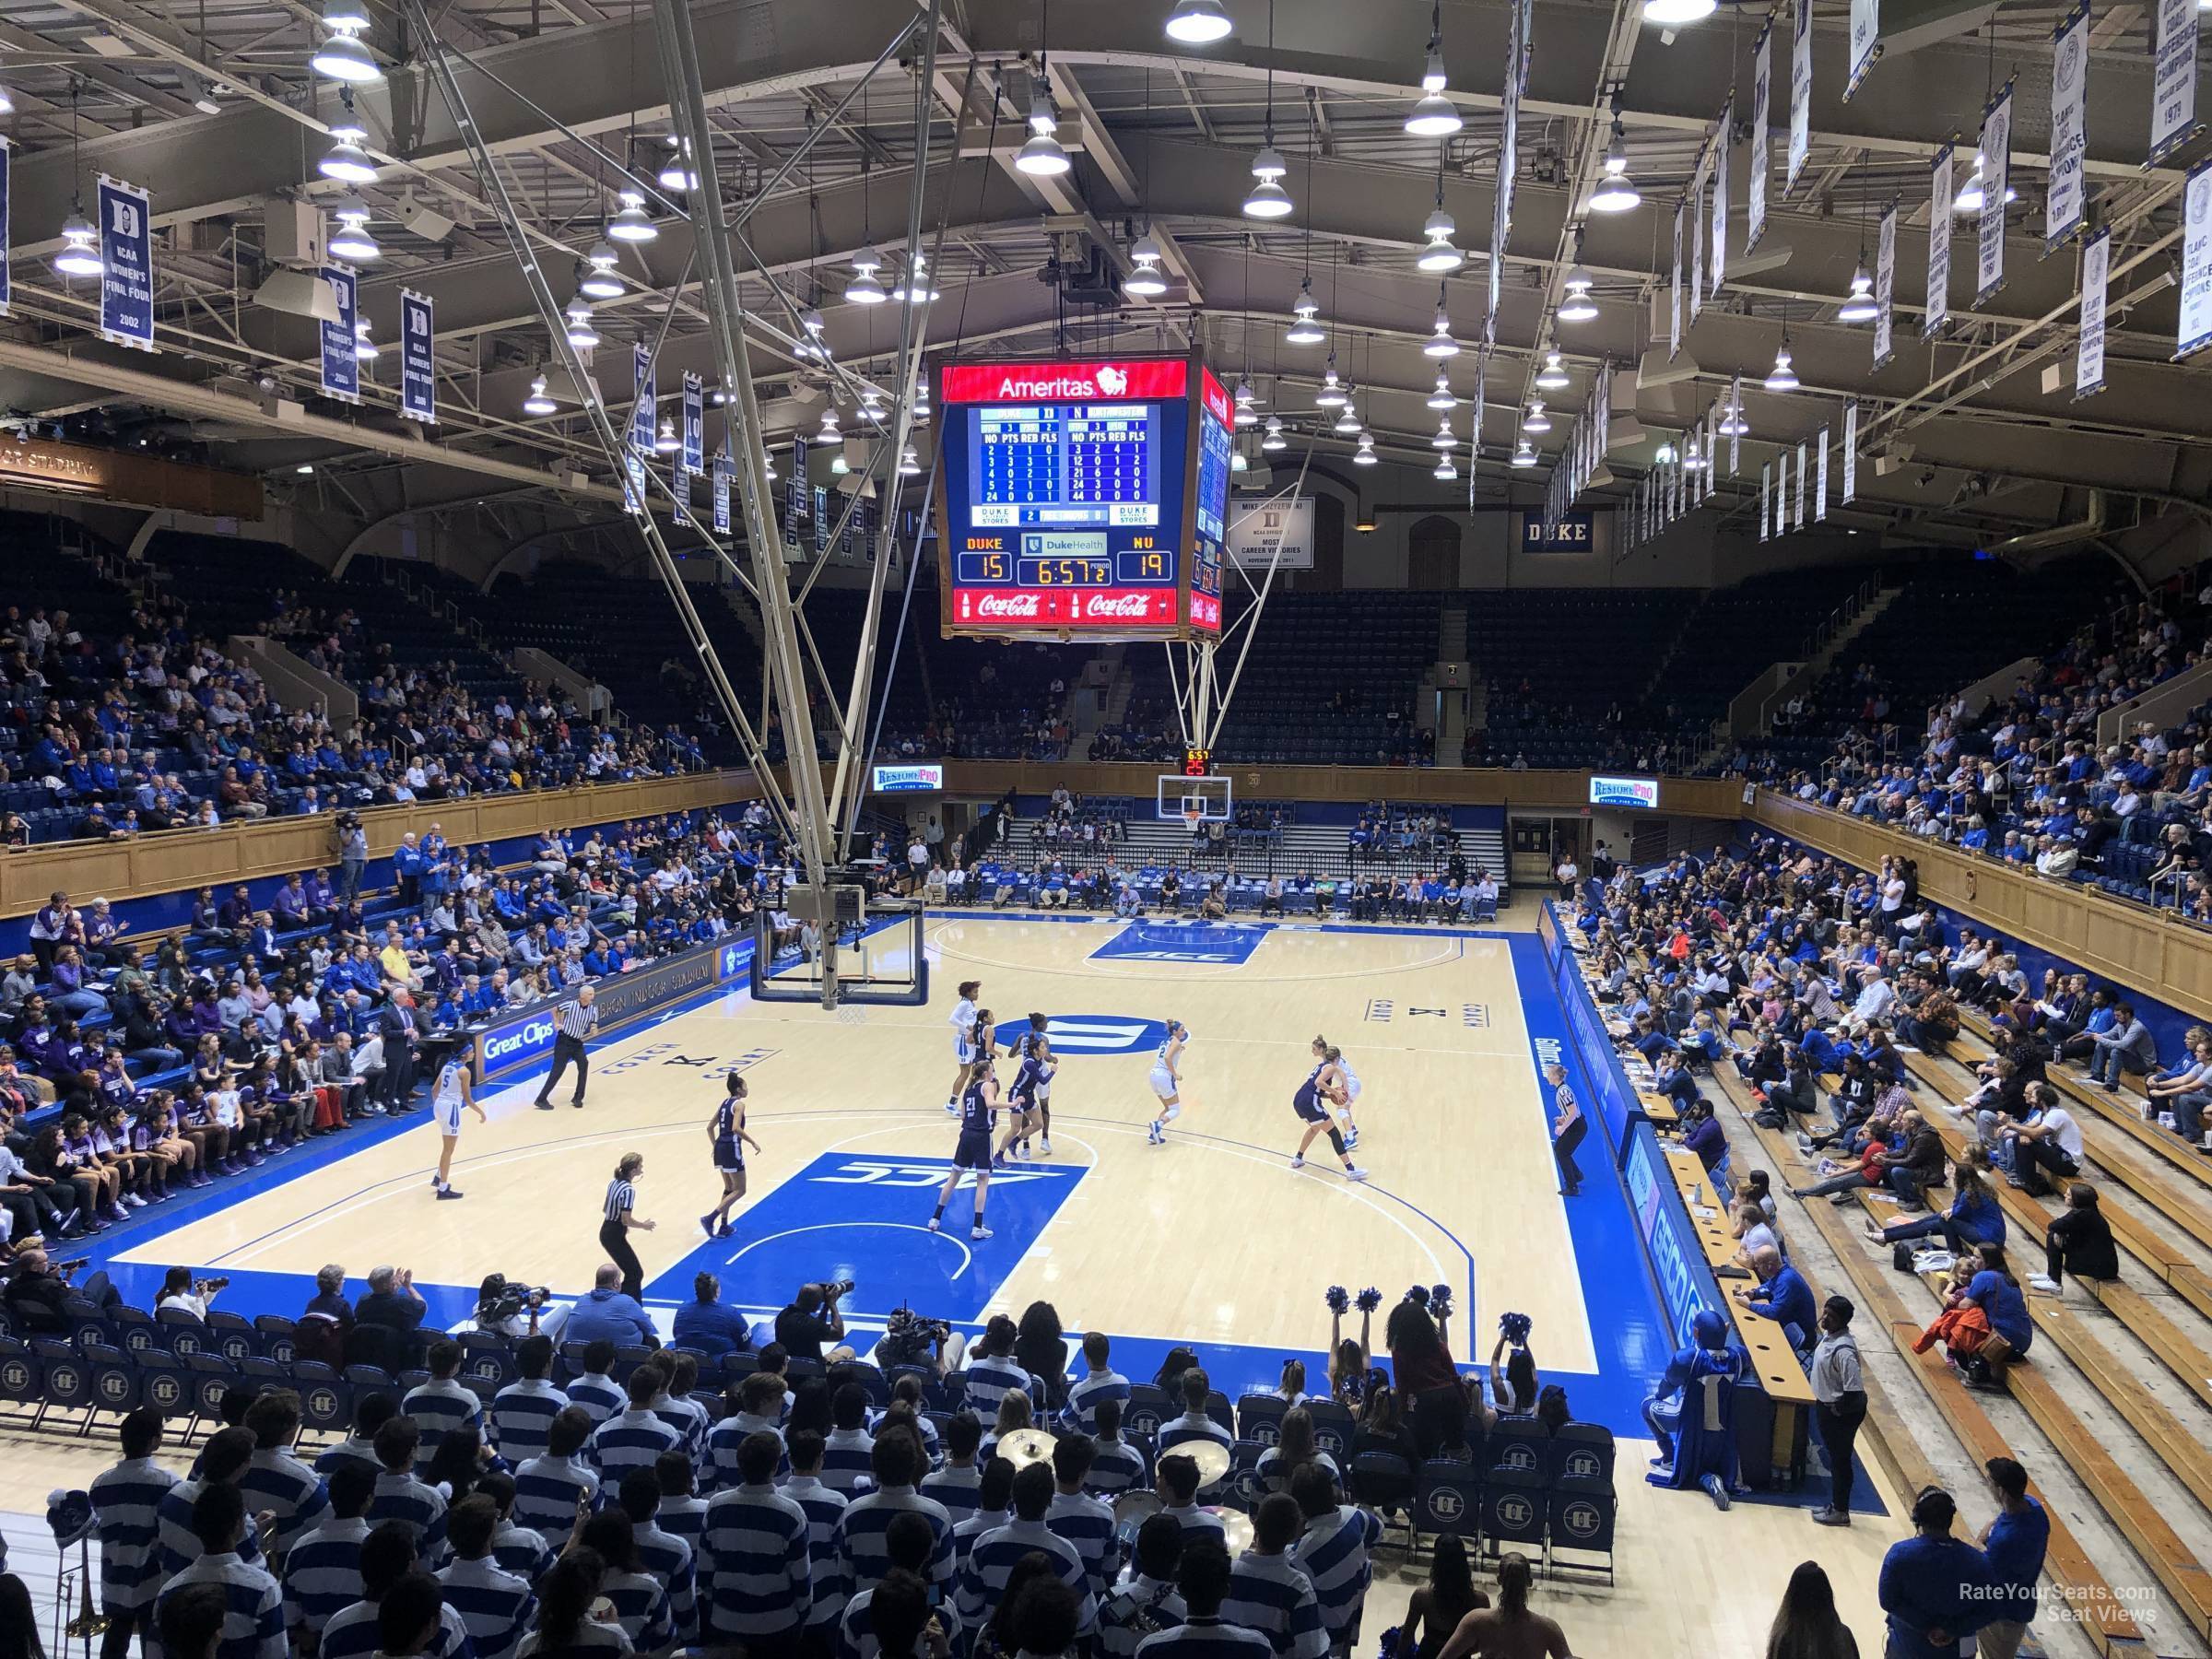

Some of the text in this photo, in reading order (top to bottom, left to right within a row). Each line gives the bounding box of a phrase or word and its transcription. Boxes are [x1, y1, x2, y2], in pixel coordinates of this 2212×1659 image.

[117, 245, 137, 262] NCAA
[111, 263, 146, 283] WOMEN'S
[105, 280, 150, 302] FINAL FOUR
[120, 314, 139, 329] 2002
[999, 378, 1094, 397] Ameritas
[985, 433, 1057, 443] NO PTS REB FLS
[1072, 431, 1145, 442] NO PTS REB FLS
[989, 445, 1052, 455] 2 2 1 0
[1076, 443, 1138, 453] 3 2 4 1
[989, 457, 1051, 466] 3 3 3 1
[1075, 455, 1139, 465] 12 0 1 2
[989, 469, 1051, 479] 4 0 2 1
[1075, 467, 1139, 479] 21 6 4 0
[990, 480, 1052, 489] 5 2 1 0
[1074, 478, 1140, 488] 24 3 0 0
[987, 492, 1053, 501] 24 0 0 1
[1074, 490, 1140, 500] 44 0 0 0
[1529, 524, 1586, 540] DUKE
[968, 538, 1003, 549] DUKE
[1047, 540, 1103, 550] DukeHealth
[1134, 537, 1153, 549] NU
[982, 555, 1003, 578] 15
[1039, 560, 1088, 584] 6:57
[1141, 554, 1161, 576] 19
[1097, 569, 1104, 582] 2
[978, 594, 1041, 616] Coca-Cola
[1087, 594, 1150, 617] Coca-Cola
[1188, 751, 1208, 760] 6:57
[1186, 760, 1204, 775] 25
[631, 965, 708, 1006] INDOOR STADIUM
[485, 1022, 553, 1059] Great Clips
[602, 1043, 682, 1075] COACH
[702, 1048, 774, 1079] COURT
[443, 1075, 450, 1088] 5
[966, 1097, 975, 1112] 21
[721, 1108, 726, 1122] 3
[1653, 1207, 1688, 1316] GEICO
